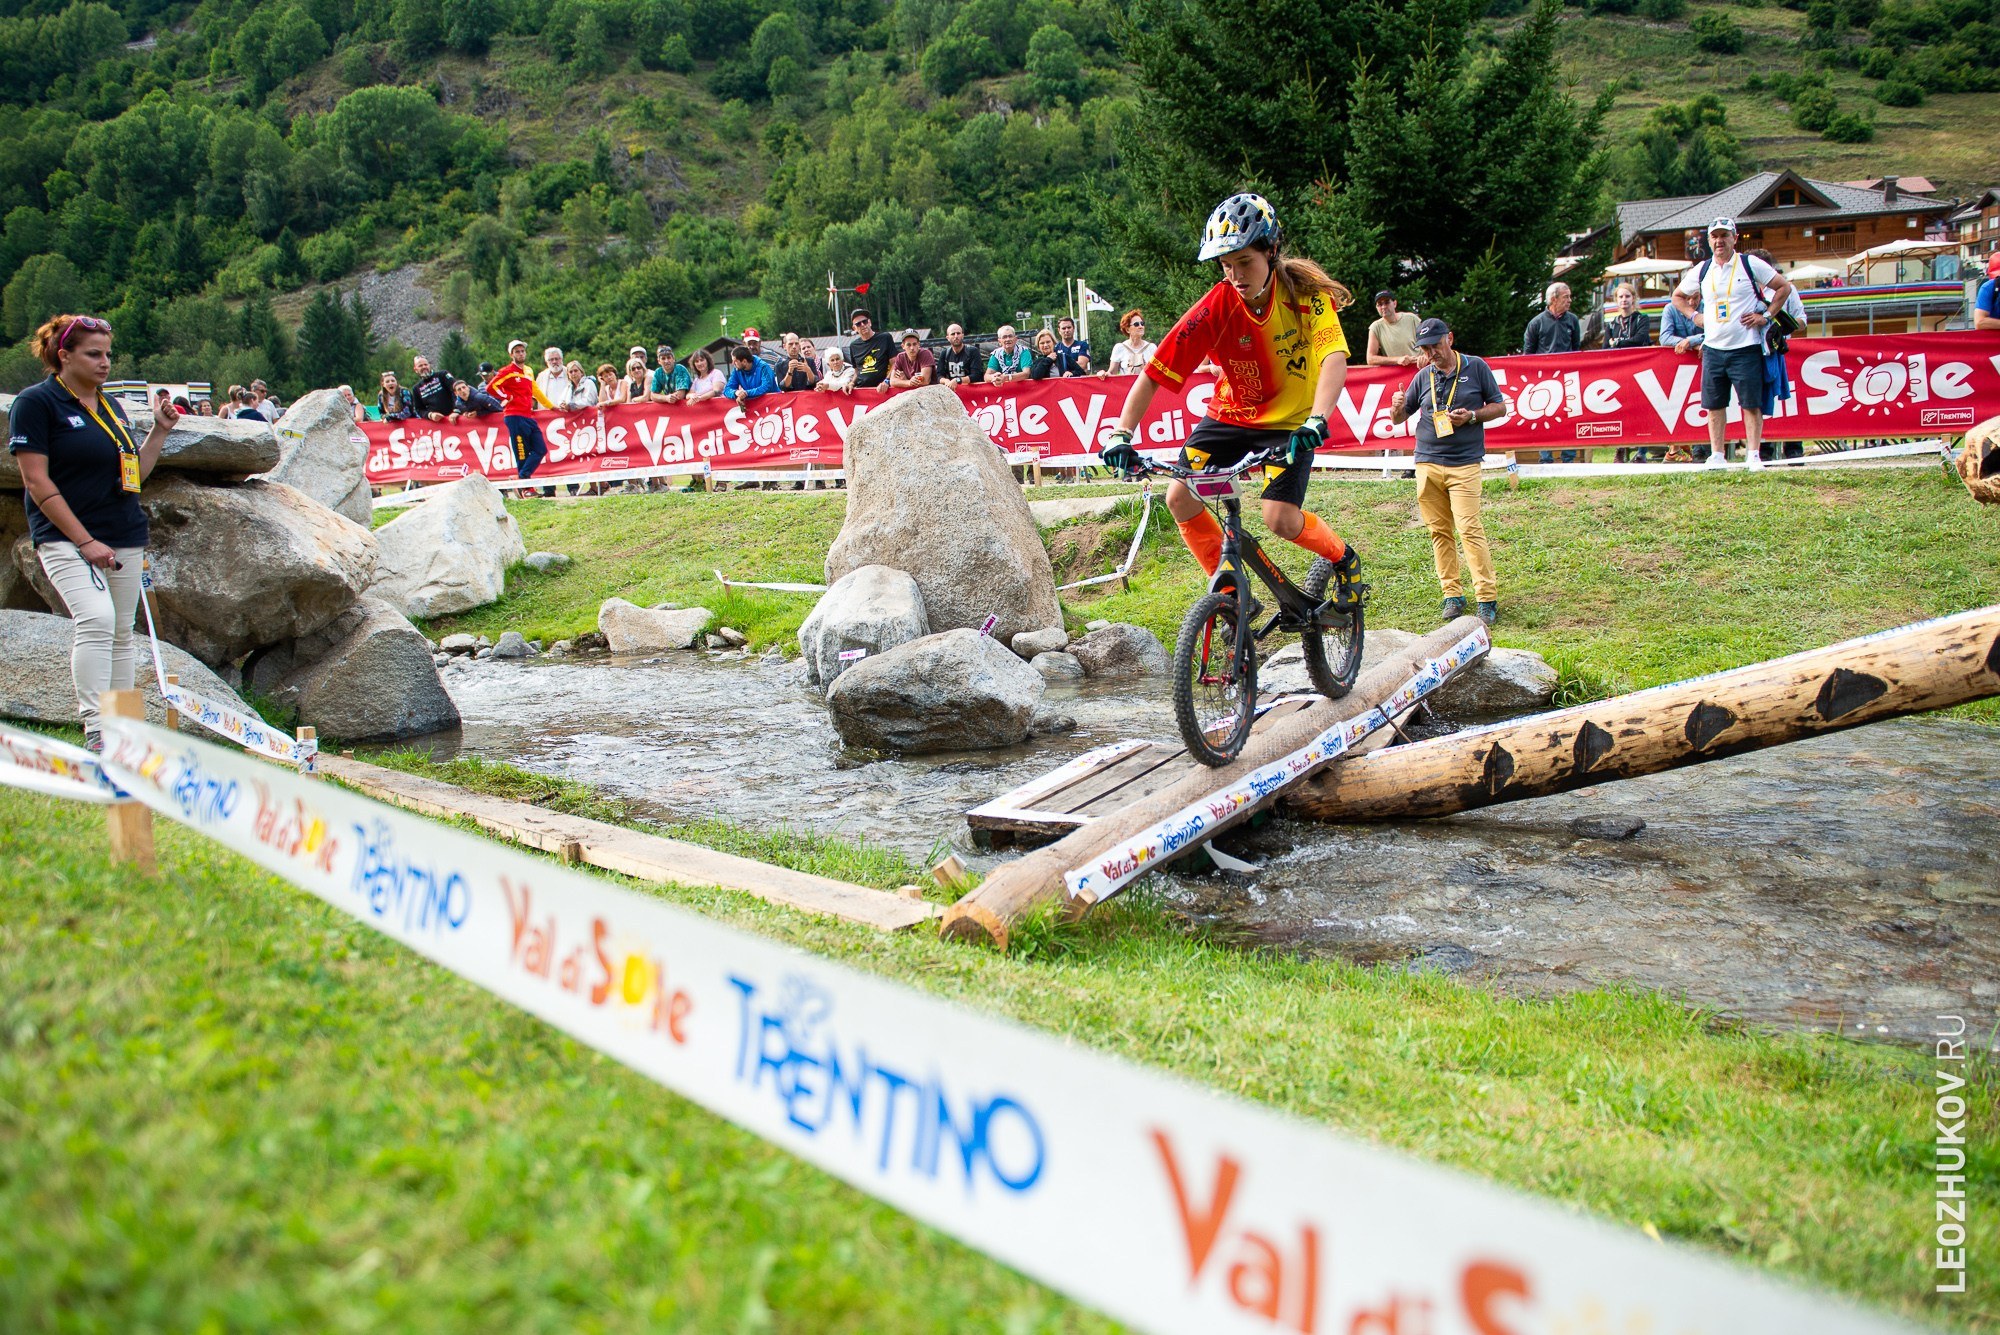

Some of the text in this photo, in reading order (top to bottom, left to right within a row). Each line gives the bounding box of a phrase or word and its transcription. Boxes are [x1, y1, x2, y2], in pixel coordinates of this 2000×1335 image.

[1801, 350, 1975, 415] Sole
[546, 412, 628, 462] Sole
[634, 416, 695, 466] Val
[698, 428, 725, 457] di
[723, 406, 821, 455] Sole
[972, 397, 1050, 439] ole
[1148, 409, 1185, 443] di
[1939, 411, 1972, 421] TRENTINO
[369, 447, 389, 473] di
[388, 427, 463, 469] Sole
[1101, 815, 1205, 884] Val di Sole TRENTINO
[351, 821, 472, 932] TRENTINO
[499, 875, 557, 980] Val
[588, 914, 693, 1046] Sole
[725, 971, 1047, 1196] TRENTINO
[1146, 1124, 1319, 1335] Val
